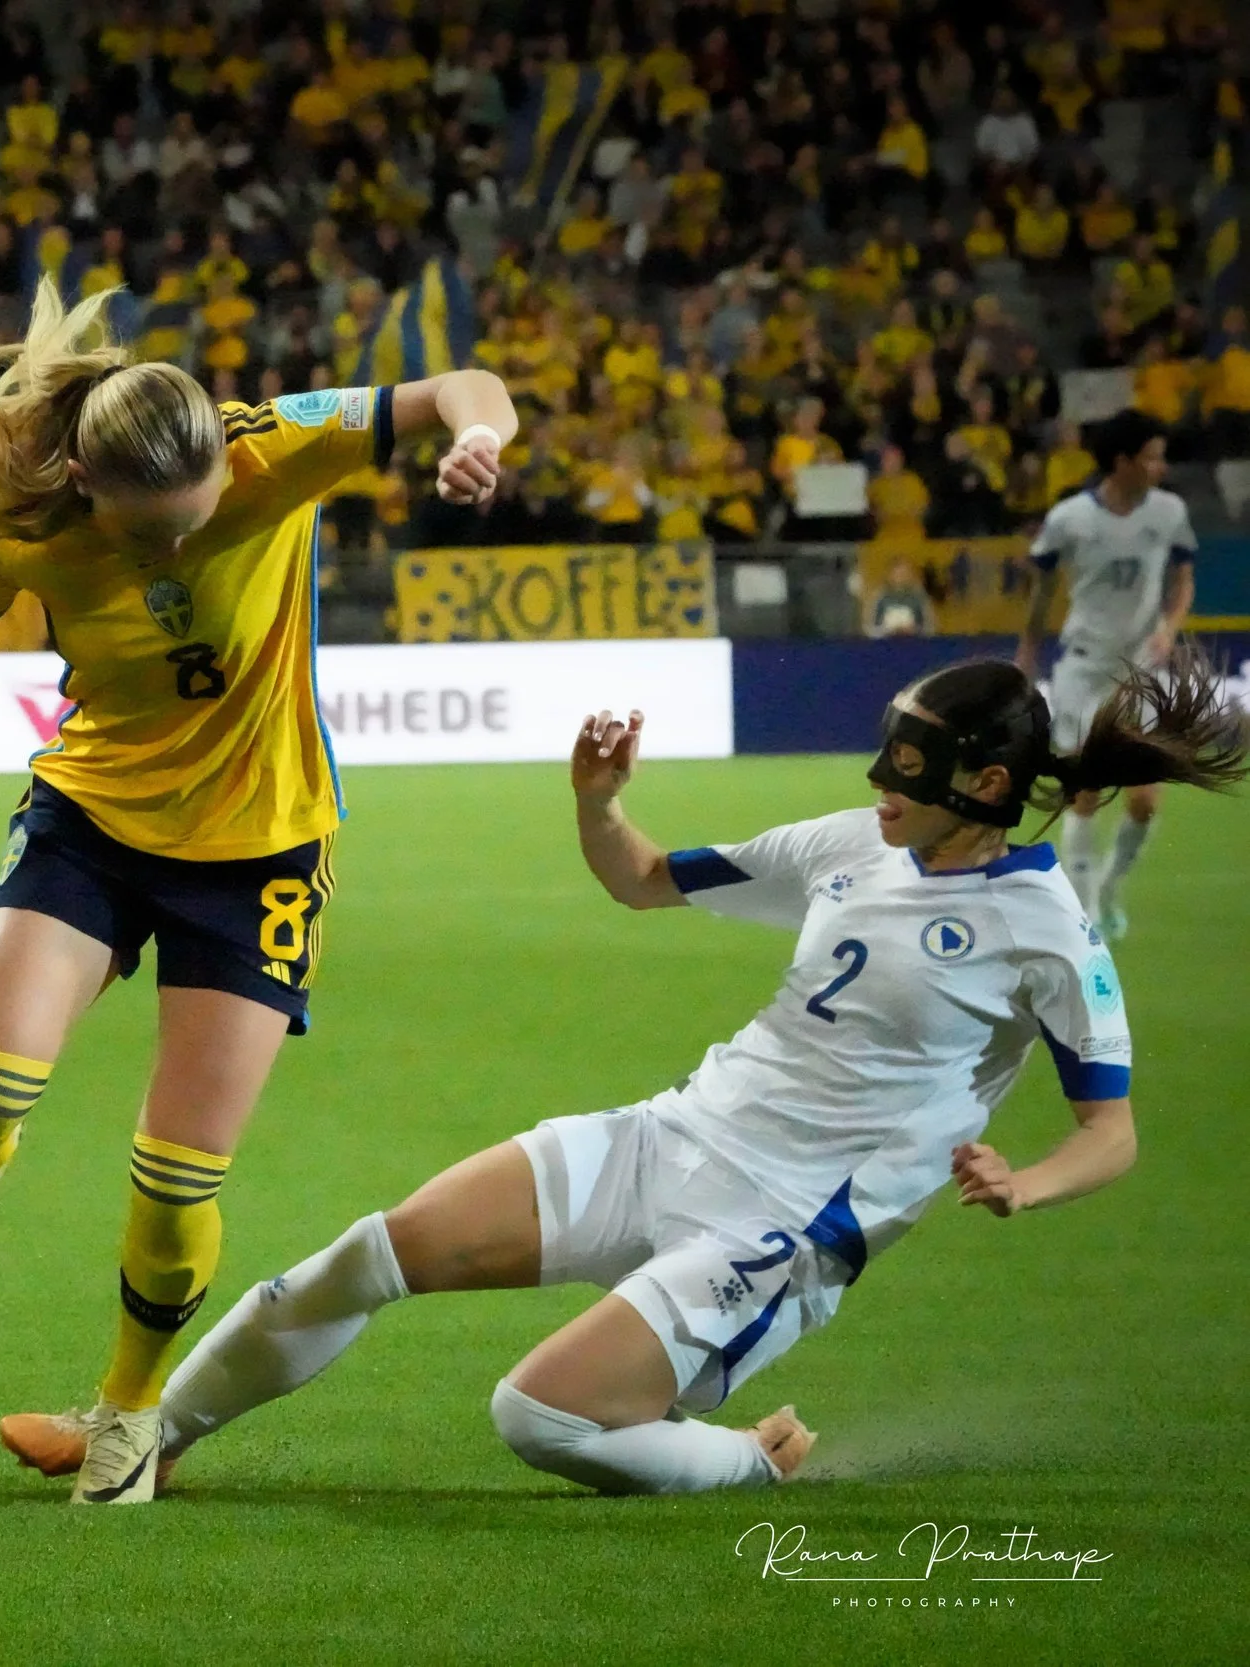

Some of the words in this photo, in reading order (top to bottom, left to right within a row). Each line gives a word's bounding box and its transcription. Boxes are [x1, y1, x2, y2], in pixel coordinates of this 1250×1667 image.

[166, 642, 226, 700] 8
[317, 686, 509, 735] NHEDE
[260, 879, 311, 961] 8
[806, 939, 868, 1024] 2
[729, 1231, 797, 1293] 2
